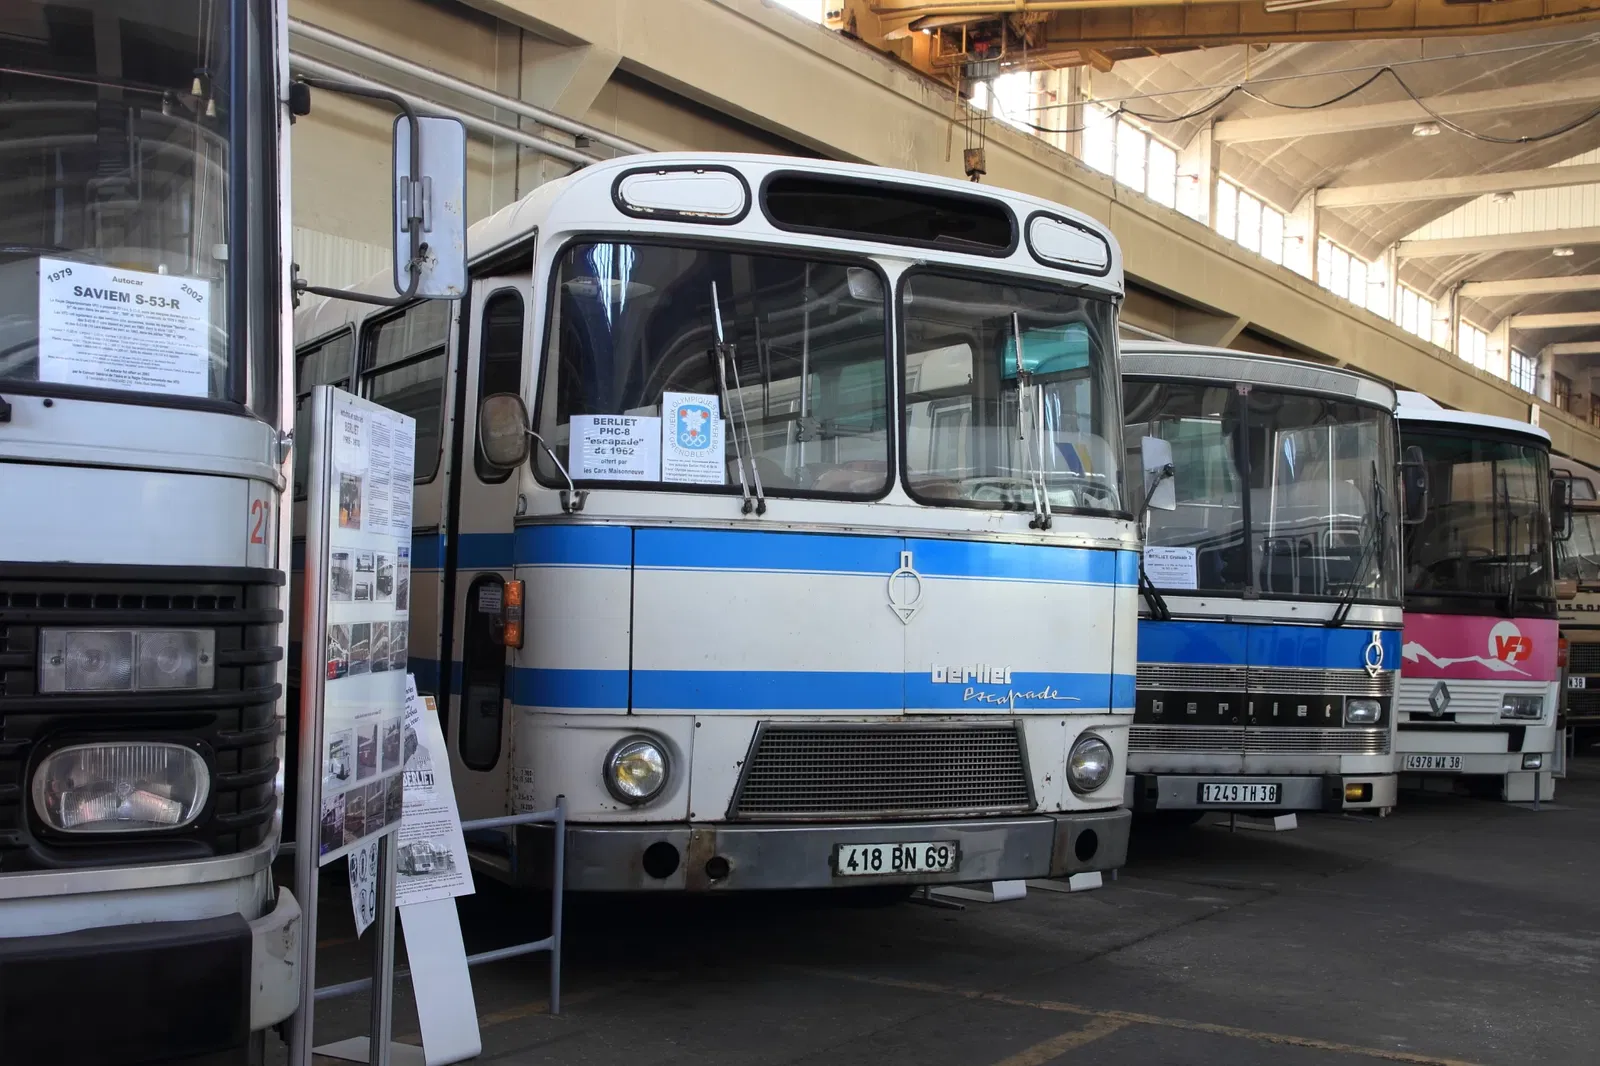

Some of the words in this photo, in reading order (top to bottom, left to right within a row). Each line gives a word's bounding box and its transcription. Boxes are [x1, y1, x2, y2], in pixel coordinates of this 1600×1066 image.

[47, 267, 73, 283] 1979
[112, 275, 144, 286] Autocar
[73, 285, 130, 303] SAVIEM
[135, 294, 180, 310] S-53-R
[180, 283, 204, 303] 2002
[593, 417, 638, 426] BERLIET
[599, 427, 631, 436] PHC-8
[585, 437, 644, 447] "escapade"
[610, 447, 635, 456] 1962
[963, 685, 1081, 715] escapade
[1409, 756, 1433, 768] 4978
[1435, 756, 1447, 768] WX
[1449, 756, 1460, 768] 38
[1205, 785, 1238, 801] 1249
[1242, 785, 1257, 801] TH
[1260, 785, 1275, 801] 38
[846, 847, 883, 872] 418
[891, 846, 917, 870] BN
[925, 845, 949, 869] 69
